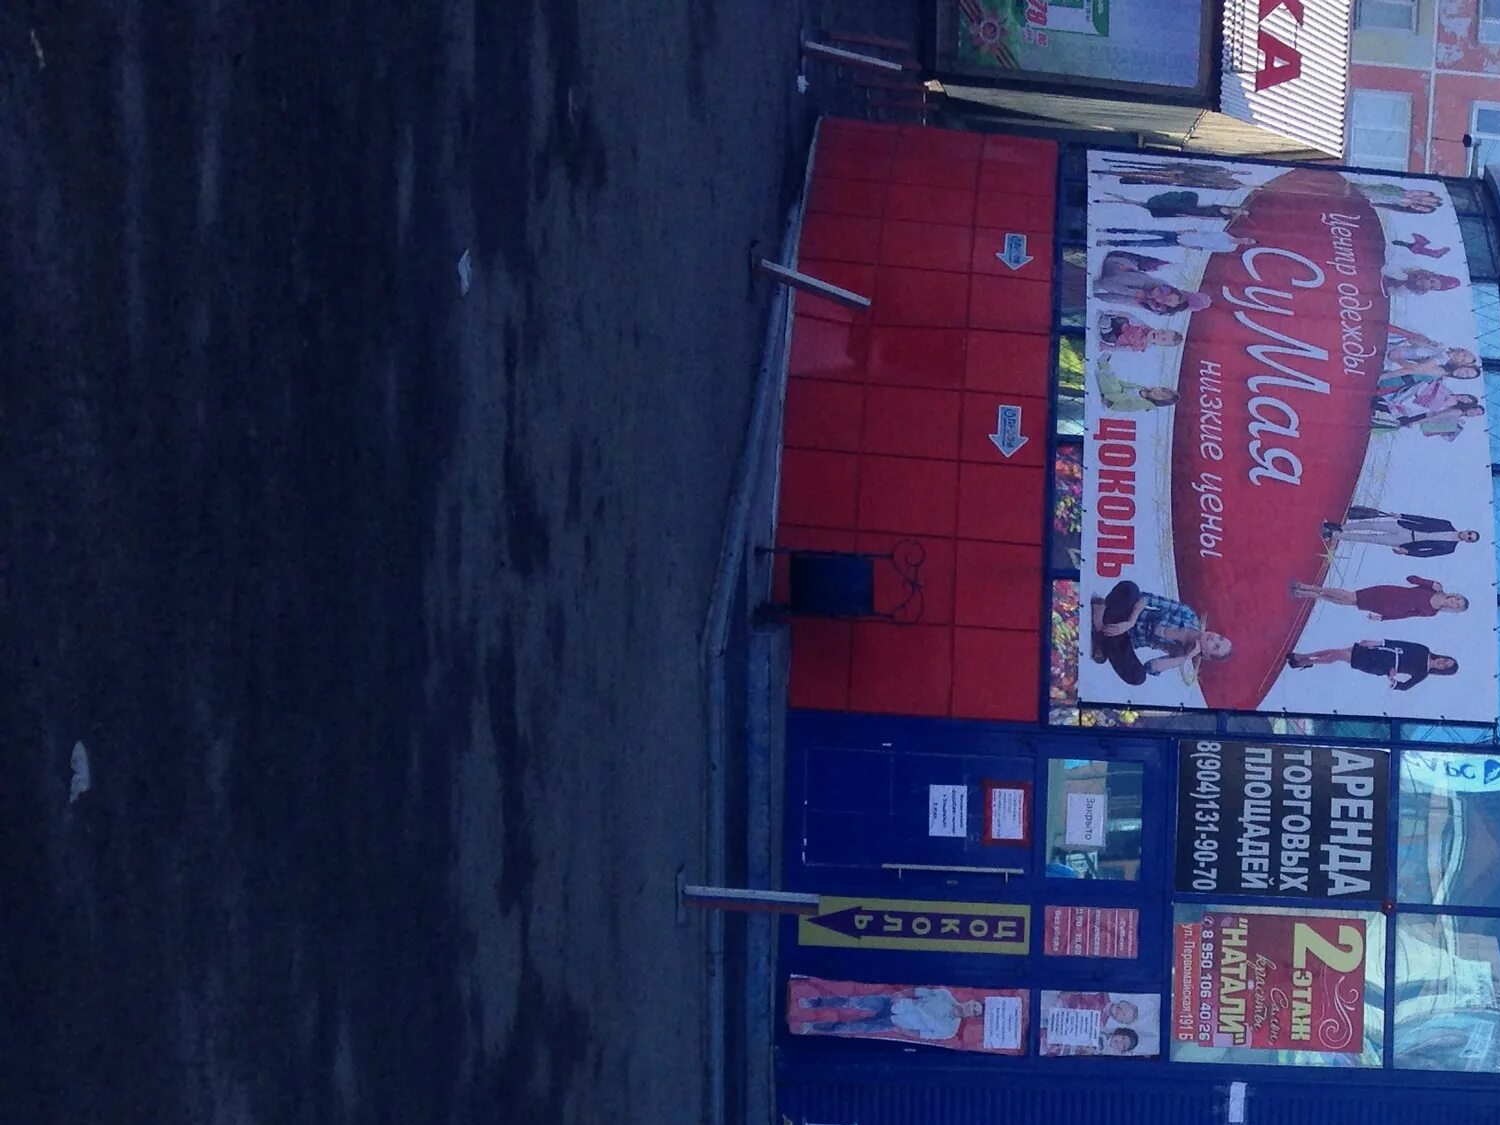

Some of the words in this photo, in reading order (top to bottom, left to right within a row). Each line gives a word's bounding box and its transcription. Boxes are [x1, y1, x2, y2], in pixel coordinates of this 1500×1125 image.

[1321, 211, 1359, 276] Центр
[1331, 282, 1373, 376] одежды
[1221, 246, 1330, 488] СуМая
[1198, 359, 1226, 462] низкие
[1095, 417, 1137, 579] ЦОКОЛЬ
[1194, 471, 1225, 558] цены
[1083, 797, 1095, 841] Закрыто
[1190, 741, 1221, 891] 8(904)131-90-70
[1236, 747, 1275, 889] ПЛОЩАДЕЙ
[1278, 750, 1313, 892] ТОРГОВЫХ
[1320, 748, 1374, 896] АРЕНДА
[854, 914, 1017, 939] ЦОКОЛЬ
[1199, 943, 1213, 970] 950
[1200, 929, 1213, 940] 8
[1292, 922, 1363, 974] 2
[1179, 940, 1194, 1012] Первомайская
[1199, 973, 1213, 998] 106
[1199, 1001, 1212, 1020] 40
[1290, 970, 1313, 1041] ЭТАЖ
[1178, 1013, 1193, 1030] 191
[1198, 1022, 1211, 1041] 26
